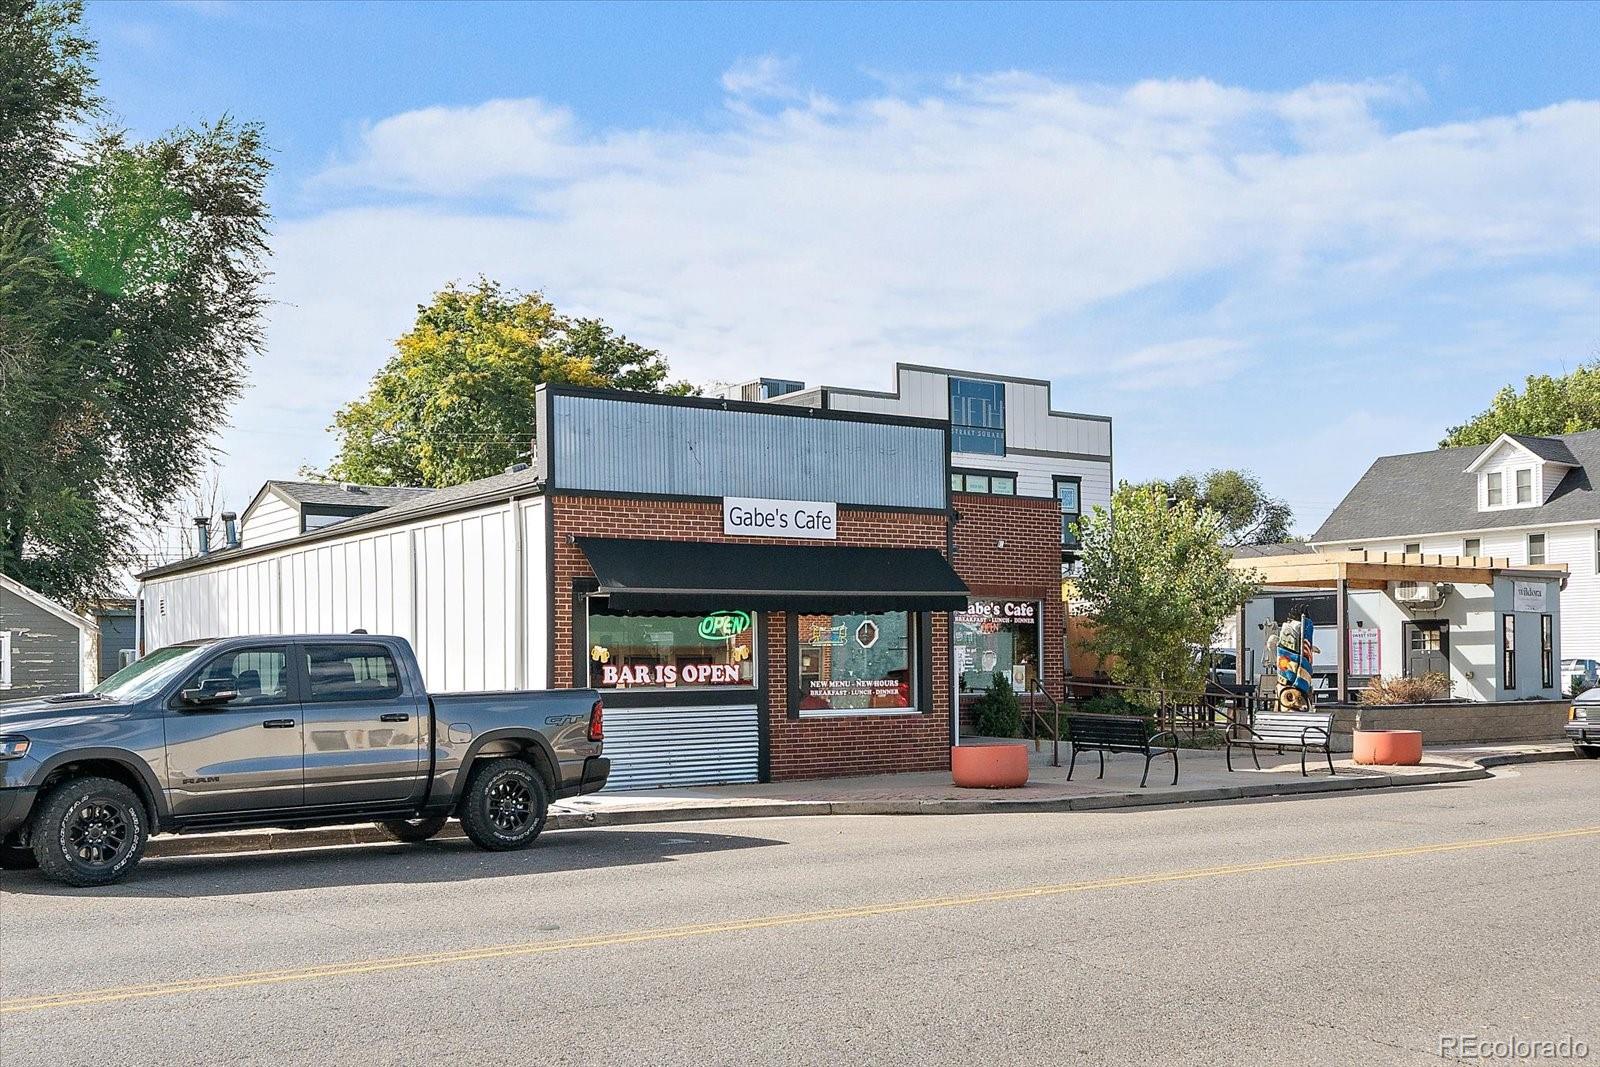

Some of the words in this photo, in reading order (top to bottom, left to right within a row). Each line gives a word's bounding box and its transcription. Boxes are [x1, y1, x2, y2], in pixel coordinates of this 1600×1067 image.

[729, 506, 789, 529] Gabe's
[794, 510, 832, 531] Cafe
[957, 602, 1000, 615] abe's
[702, 615, 744, 634] OPEN
[602, 665, 651, 684] BAR
[655, 665, 677, 683] IS
[681, 664, 740, 683] OPEN
[810, 680, 828, 688] NEW
[829, 680, 851, 688] MENU
[874, 679, 899, 687] HOURS
[182, 776, 220, 785] RAM
